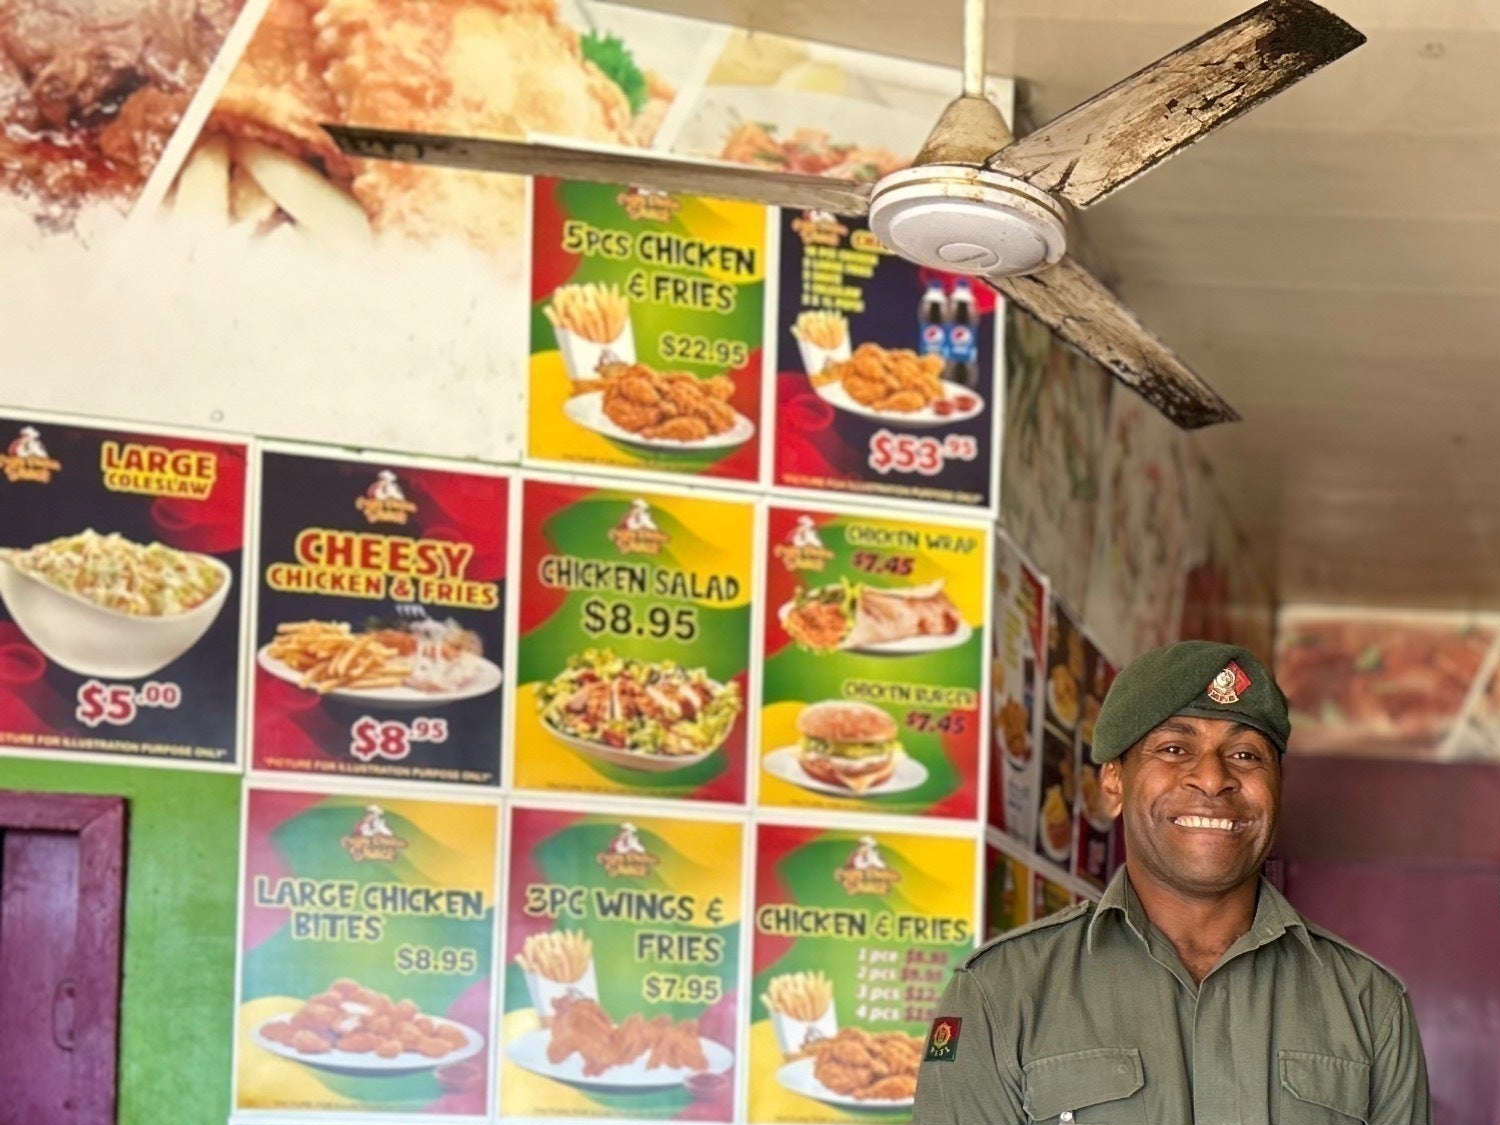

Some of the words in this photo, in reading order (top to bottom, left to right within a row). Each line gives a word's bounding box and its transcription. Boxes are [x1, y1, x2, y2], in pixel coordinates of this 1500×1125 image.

[564, 222, 631, 257] 5PCS
[637, 233, 758, 276] CHICKEN
[627, 272, 646, 299] &
[653, 275, 735, 311] FRIES
[661, 332, 748, 367] $22.95
[103, 443, 215, 479] LARGE
[106, 471, 213, 497] COLESLAW
[297, 530, 474, 579] CHEESY
[268, 565, 385, 597] CHICKEN
[390, 579, 413, 599] &
[420, 582, 498, 608] FRIES
[539, 558, 648, 593] CHICKEN
[655, 569, 741, 602] SALAD
[583, 600, 697, 641] $8.95
[80, 683, 178, 724] $5.00
[352, 718, 447, 758] $8.95
[255, 876, 356, 908] LARGE
[362, 884, 485, 918] CHICKEN
[526, 886, 586, 916] 3PC
[594, 890, 696, 922] WINGS
[706, 897, 724, 924] &
[293, 912, 383, 942] BITES
[758, 907, 868, 936] CHICKEN
[874, 918, 891, 938] &
[898, 915, 970, 942] FRIES
[396, 947, 476, 973] $8.95
[636, 932, 723, 963] FRIES
[644, 976, 720, 1001] $7.95
